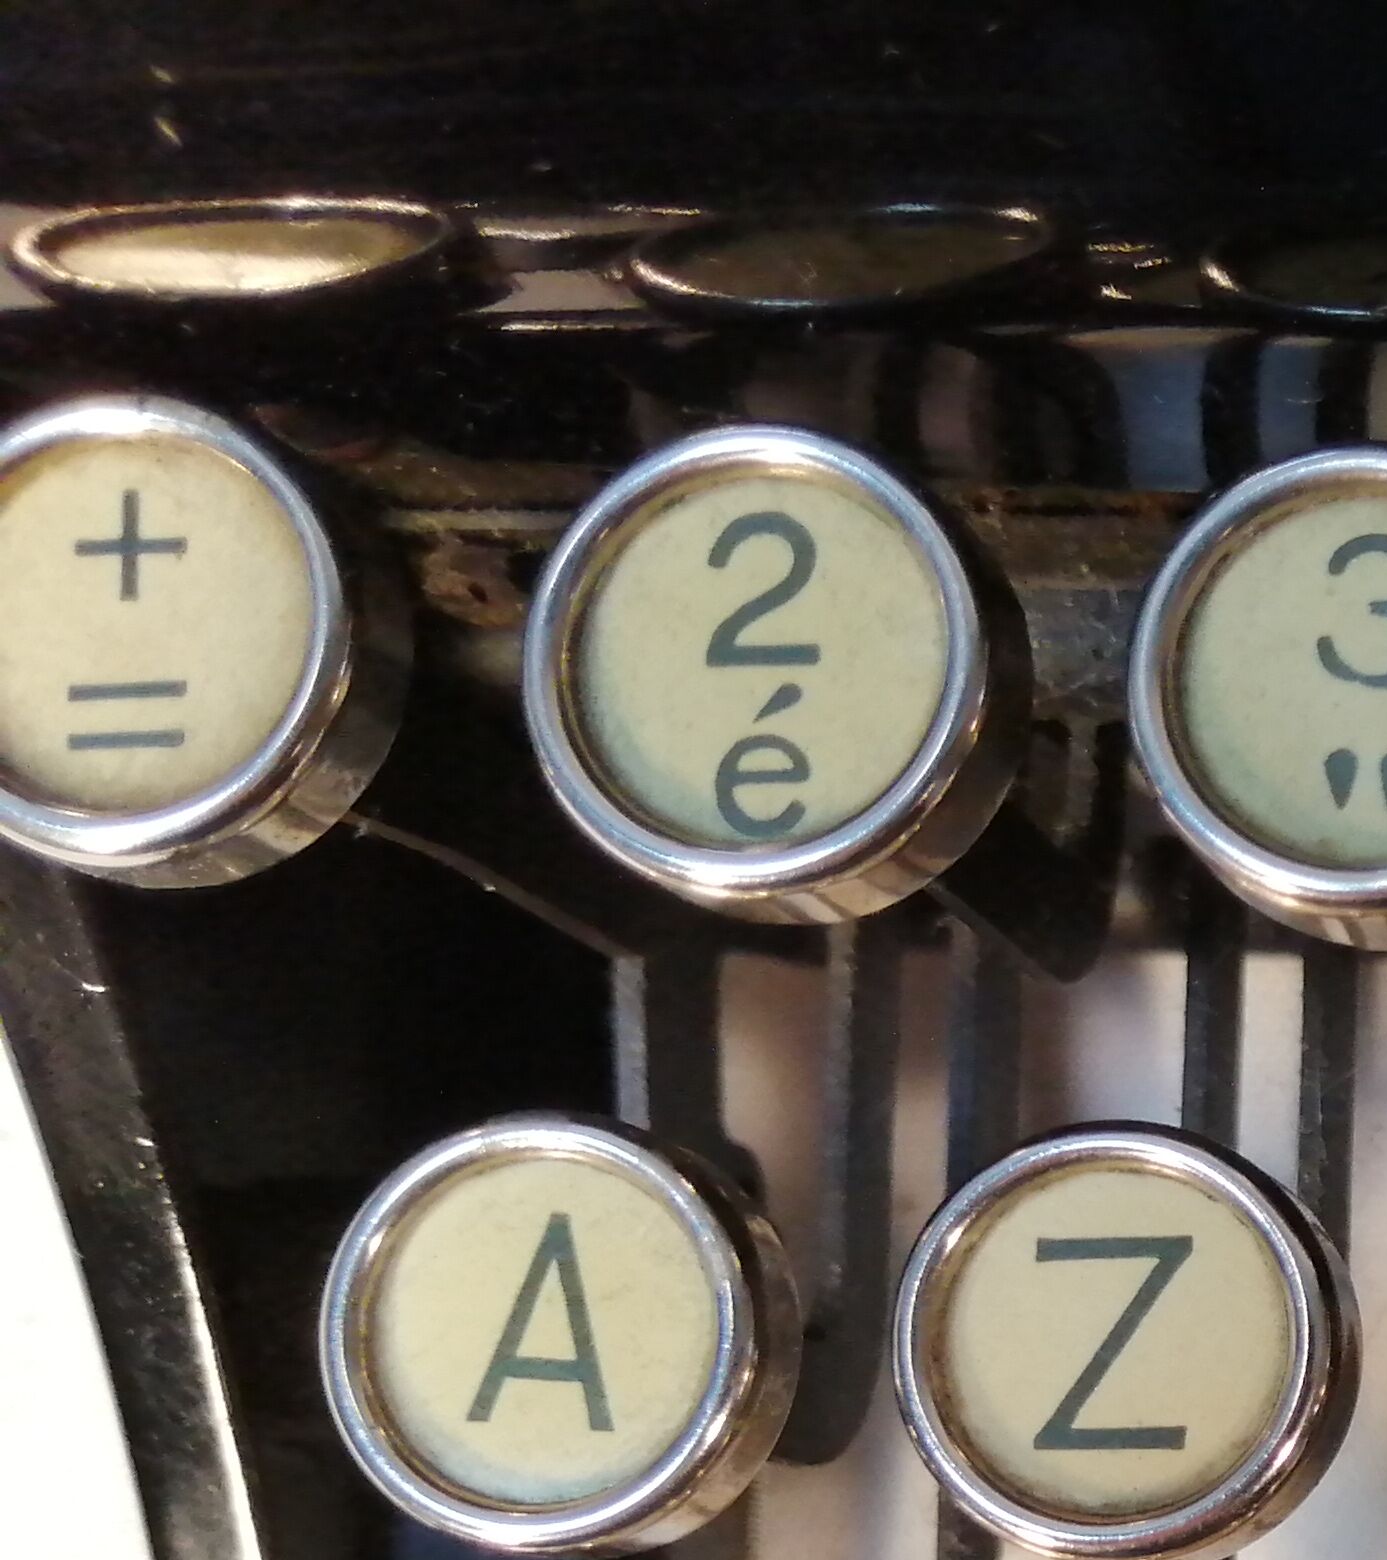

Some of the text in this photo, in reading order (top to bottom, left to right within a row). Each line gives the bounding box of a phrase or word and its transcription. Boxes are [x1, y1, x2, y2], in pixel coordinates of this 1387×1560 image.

[75, 489, 187, 601] +
[706, 511, 821, 667] 2
[67, 681, 187, 751] =
[714, 684, 813, 838] é
[467, 1213, 614, 1431] A
[1034, 1236, 1193, 1450] Z
